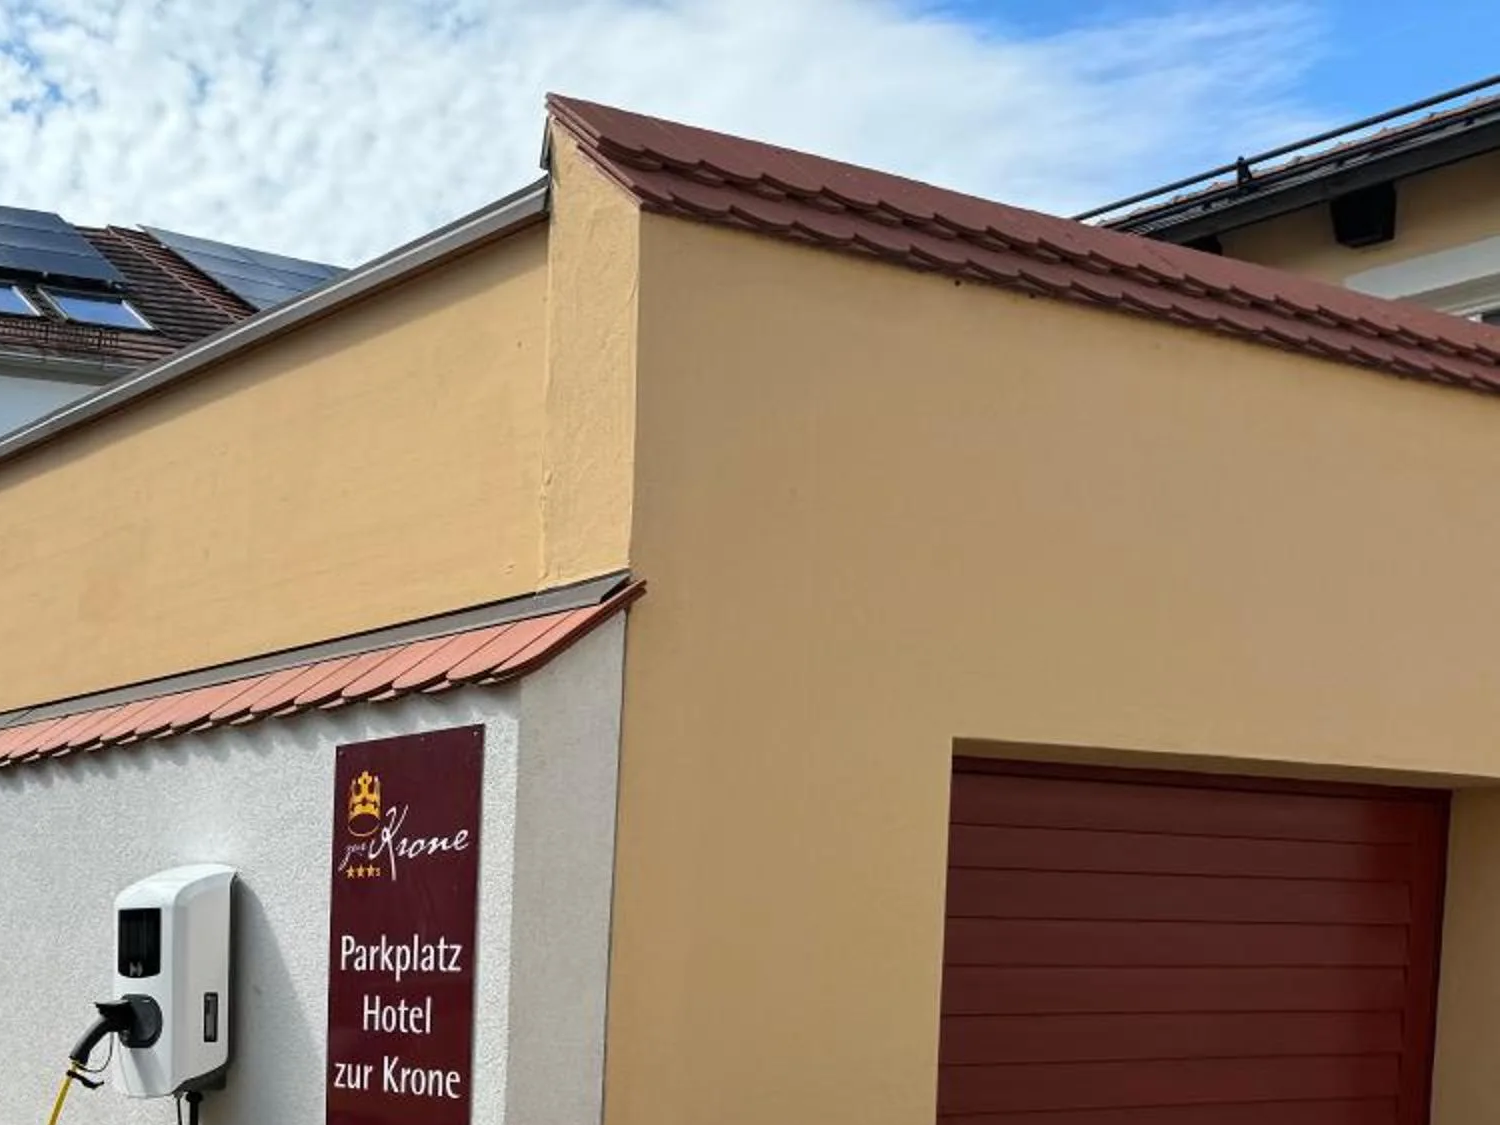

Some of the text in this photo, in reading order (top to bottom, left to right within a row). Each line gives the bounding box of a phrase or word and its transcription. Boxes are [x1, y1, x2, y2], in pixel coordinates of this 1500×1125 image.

[368, 803, 469, 882] Krone
[340, 933, 463, 982] Parkplatz
[362, 994, 432, 1034] Hotel
[334, 1055, 461, 1099] zur Krone
